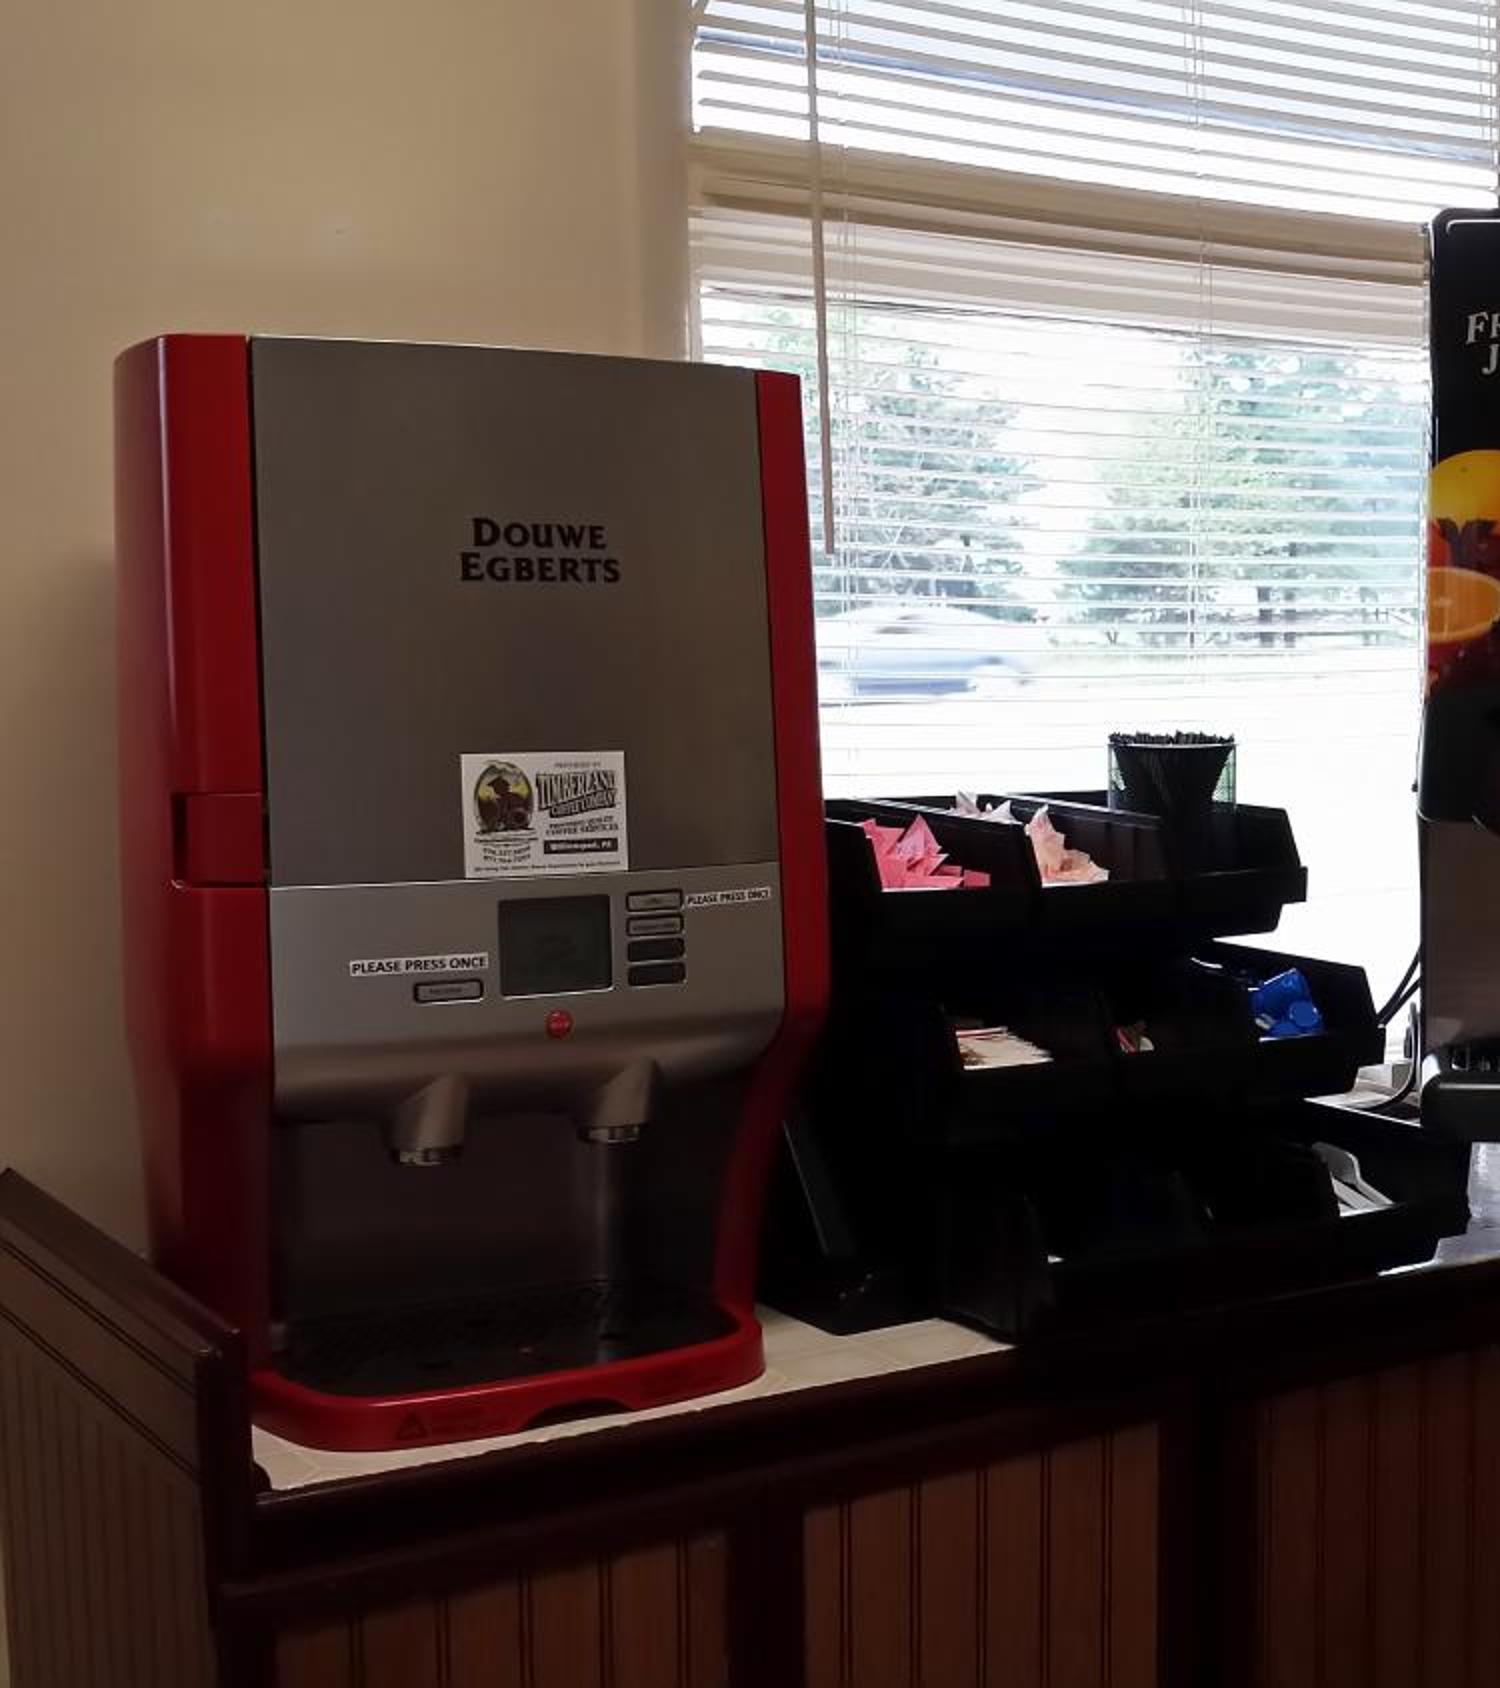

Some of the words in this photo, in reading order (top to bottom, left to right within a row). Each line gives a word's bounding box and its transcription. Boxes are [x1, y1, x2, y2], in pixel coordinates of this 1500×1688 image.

[472, 517, 607, 549] DOUWE
[460, 552, 620, 582] EGBERTS
[687, 893, 718, 905] PLEASE
[720, 891, 746, 902] PRESS
[748, 889, 769, 900] ONCE
[352, 960, 401, 975] PLEASE
[405, 958, 447, 971] PRESS
[450, 956, 486, 969] ONCE
